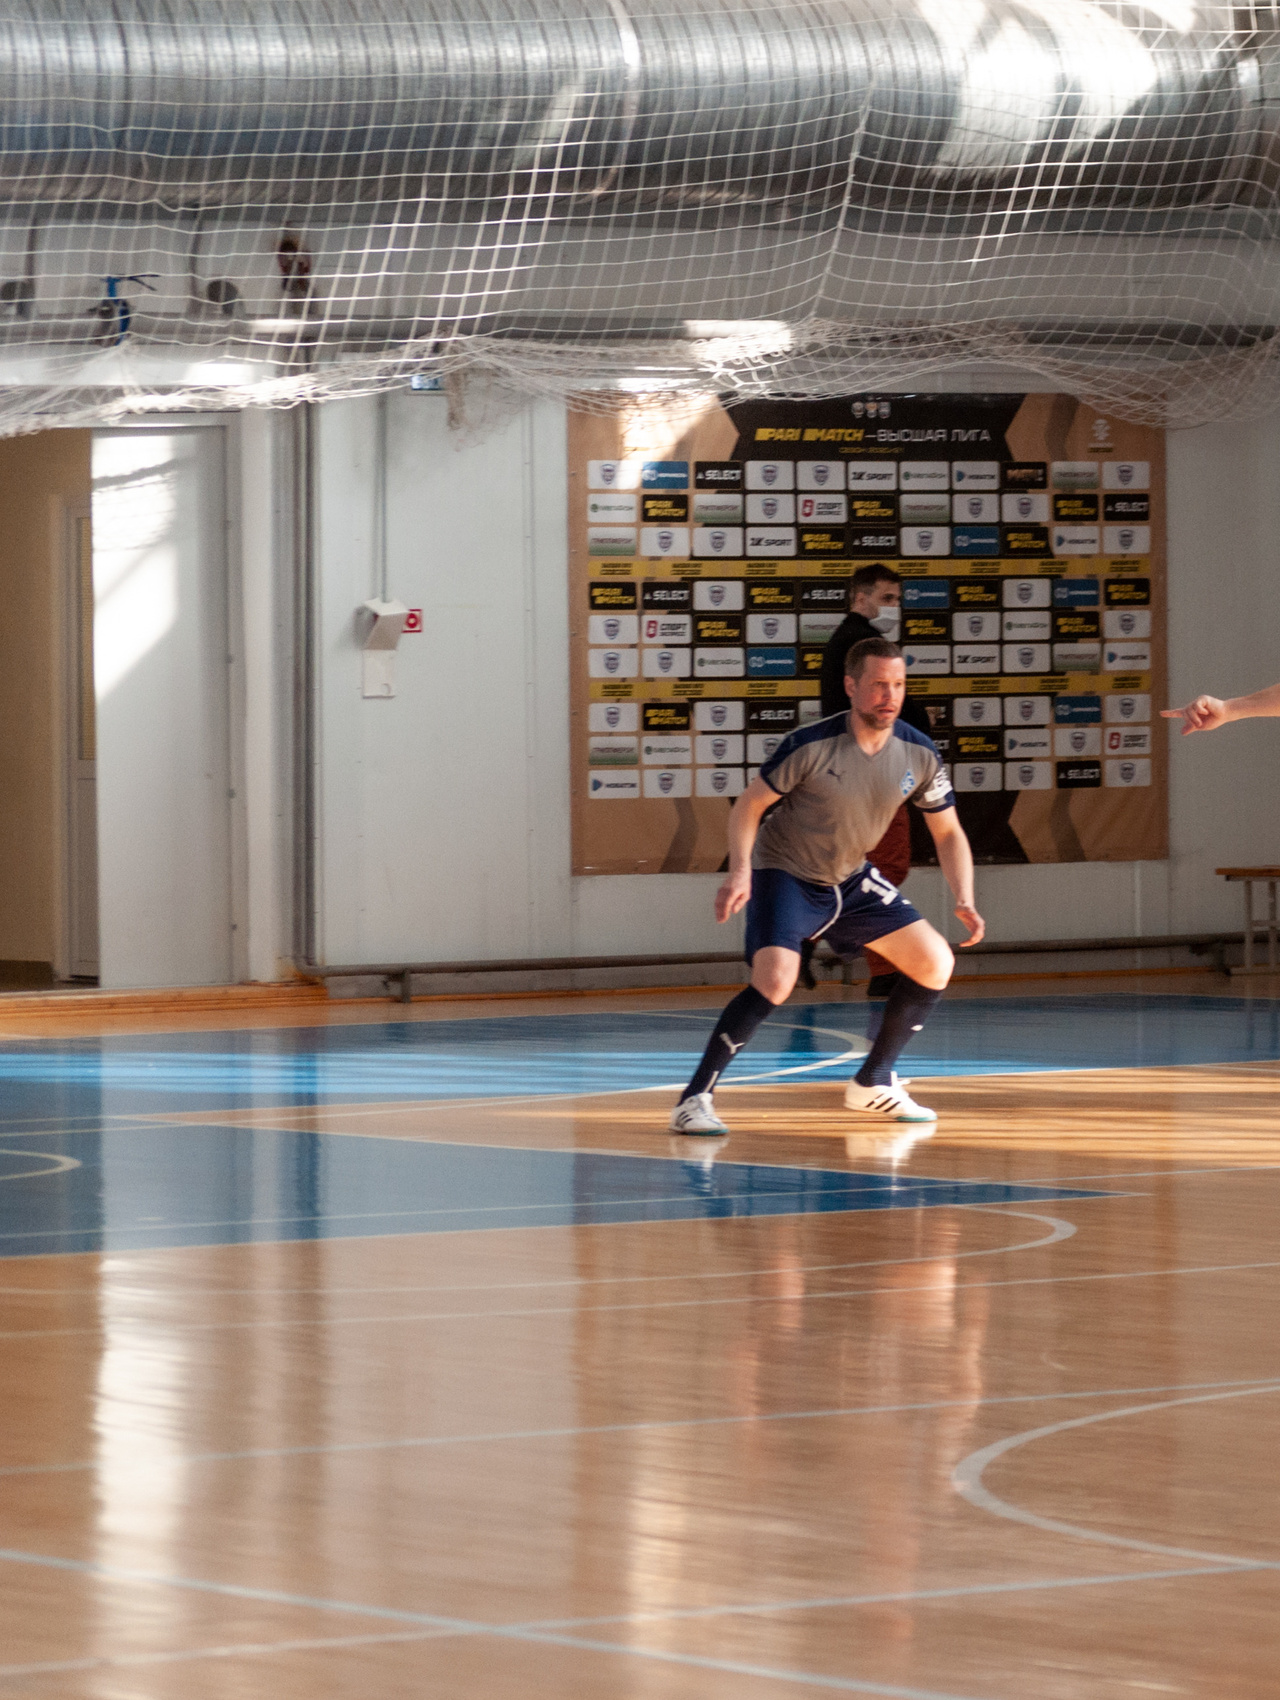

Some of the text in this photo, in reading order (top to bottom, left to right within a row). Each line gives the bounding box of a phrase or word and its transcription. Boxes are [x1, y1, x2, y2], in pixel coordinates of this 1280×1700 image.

[757, 428, 801, 441] PARI
[805, 428, 864, 441] MATCH
[951, 429, 991, 441] ЛИГА
[705, 470, 742, 481] SELECT
[866, 473, 894, 481] SPORT
[1114, 502, 1149, 512] SELECT
[765, 538, 792, 547] SPORT
[861, 536, 897, 547] SELECT
[653, 590, 690, 601] SELECT
[811, 589, 846, 600] SELECT
[970, 656, 996, 664] SPORT
[760, 710, 795, 720] SELECT
[1067, 768, 1100, 779] SELECT
